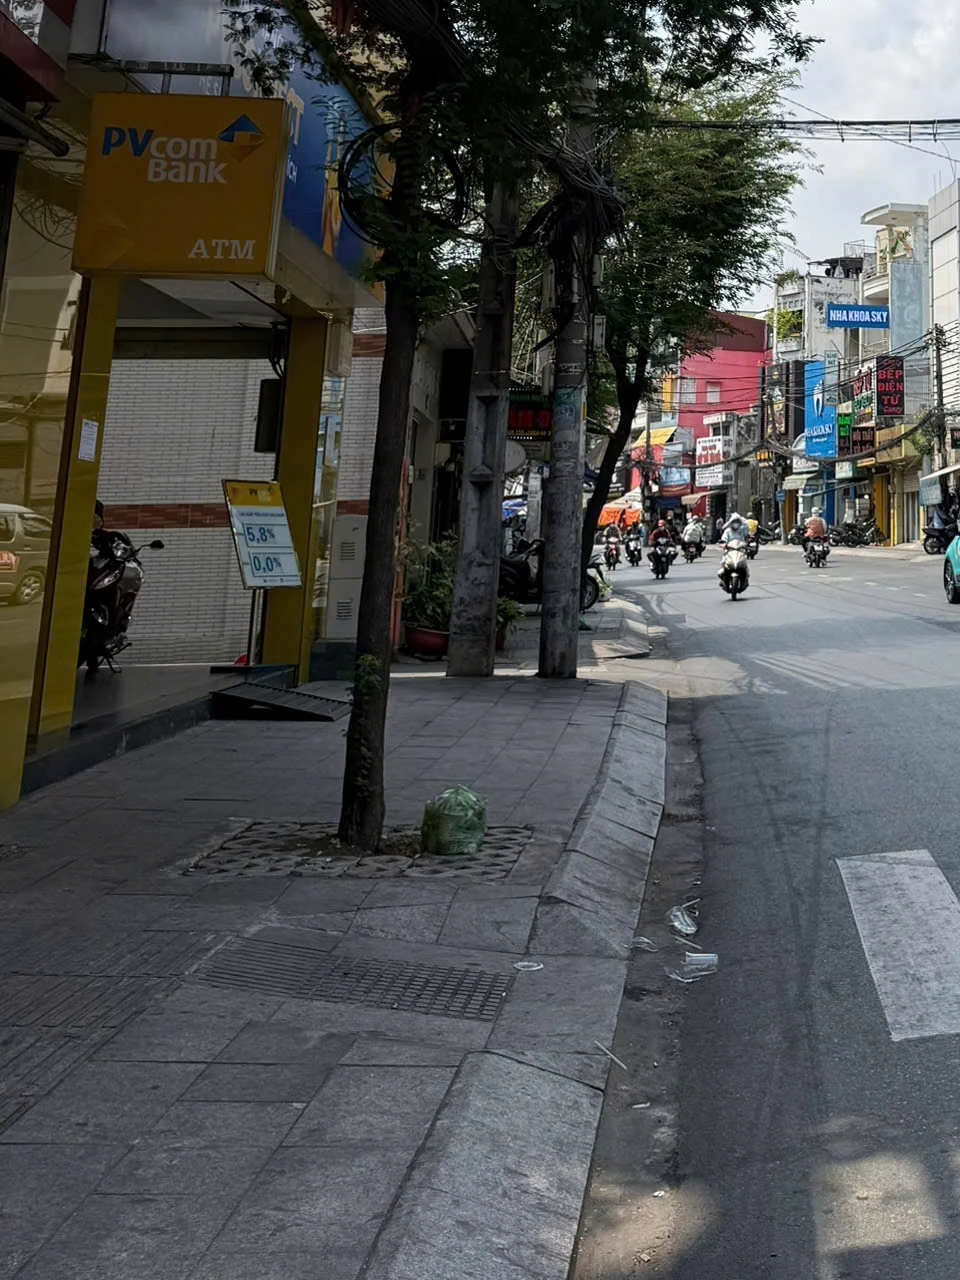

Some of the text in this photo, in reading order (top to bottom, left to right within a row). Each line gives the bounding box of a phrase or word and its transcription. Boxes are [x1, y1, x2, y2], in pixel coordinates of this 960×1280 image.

[147, 160, 229, 184] Bank
[187, 239, 256, 260] ATM
[830, 310, 888, 322] NHA KHOA SKY
[246, 526, 276, 544] 5,8%
[253, 556, 282, 573] 0,0%
